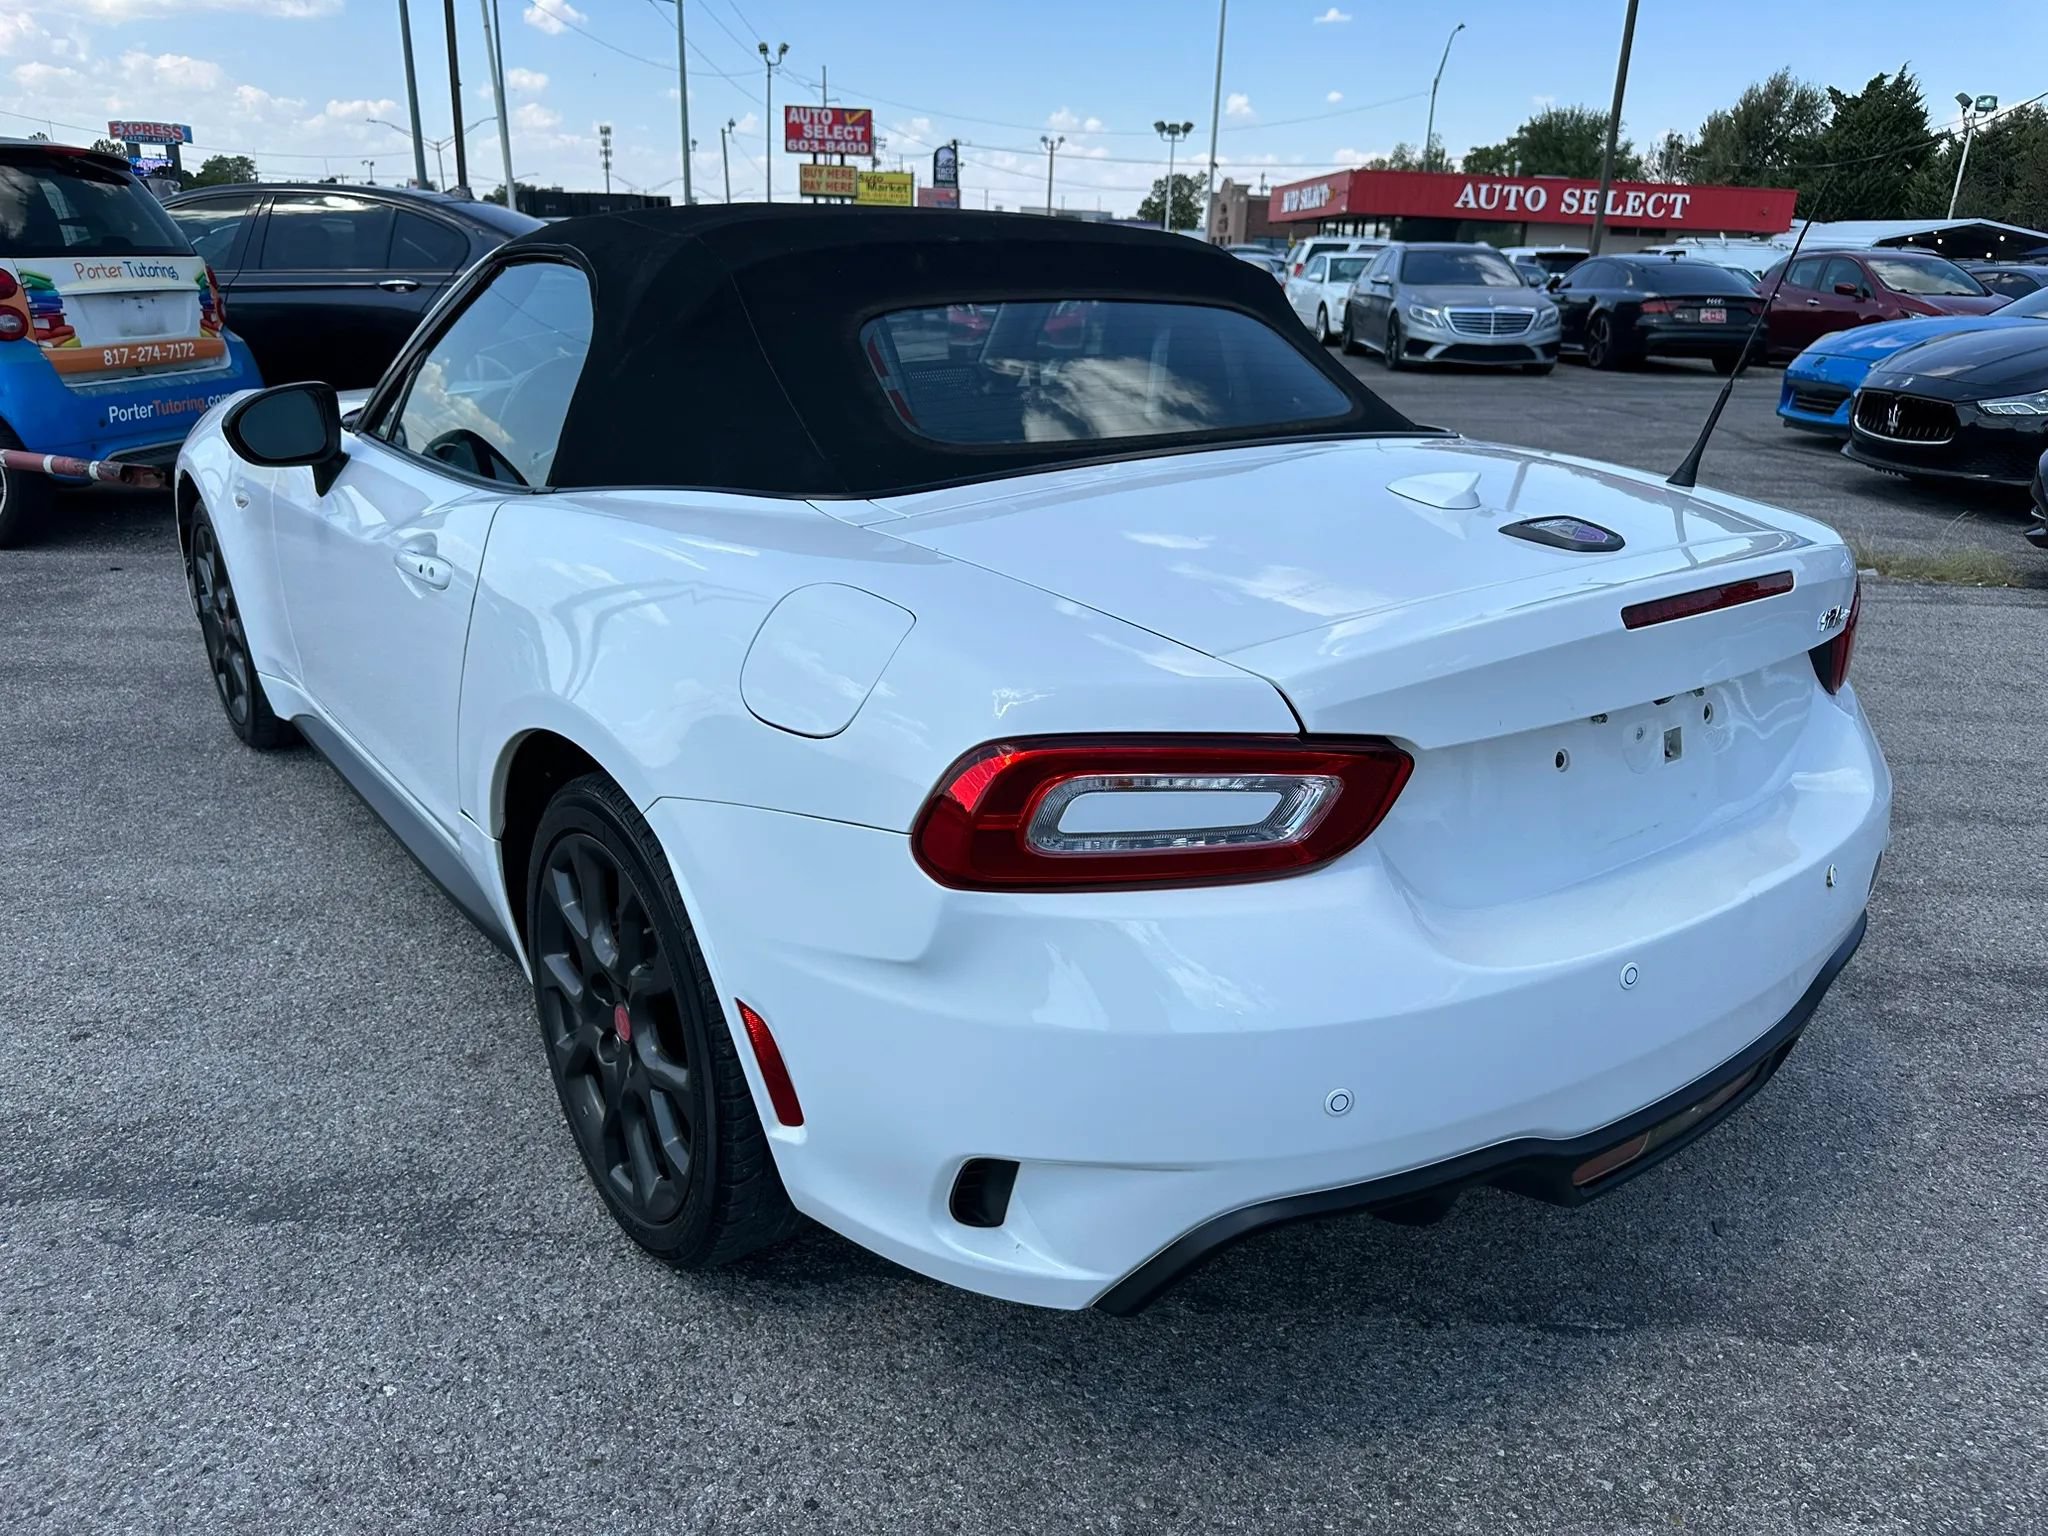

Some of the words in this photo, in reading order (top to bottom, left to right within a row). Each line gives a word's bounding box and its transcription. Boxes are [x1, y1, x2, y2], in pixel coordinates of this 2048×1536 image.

[789, 108, 833, 125] AUTO
[110, 122, 184, 142] EXPRESS
[803, 125, 865, 140] SELECT
[786, 139, 869, 154] 603-8400
[803, 167, 824, 178] BUY
[827, 169, 853, 181] HERE
[803, 180, 823, 191] PAY
[826, 182, 853, 193] HERE
[867, 183, 907, 193] Market
[1454, 182, 1548, 212] AUTO
[1560, 187, 1690, 219] SELECT
[73, 262, 122, 280] Porter
[122, 261, 179, 280] Tutoring
[103, 342, 196, 366] 817-274-7172
